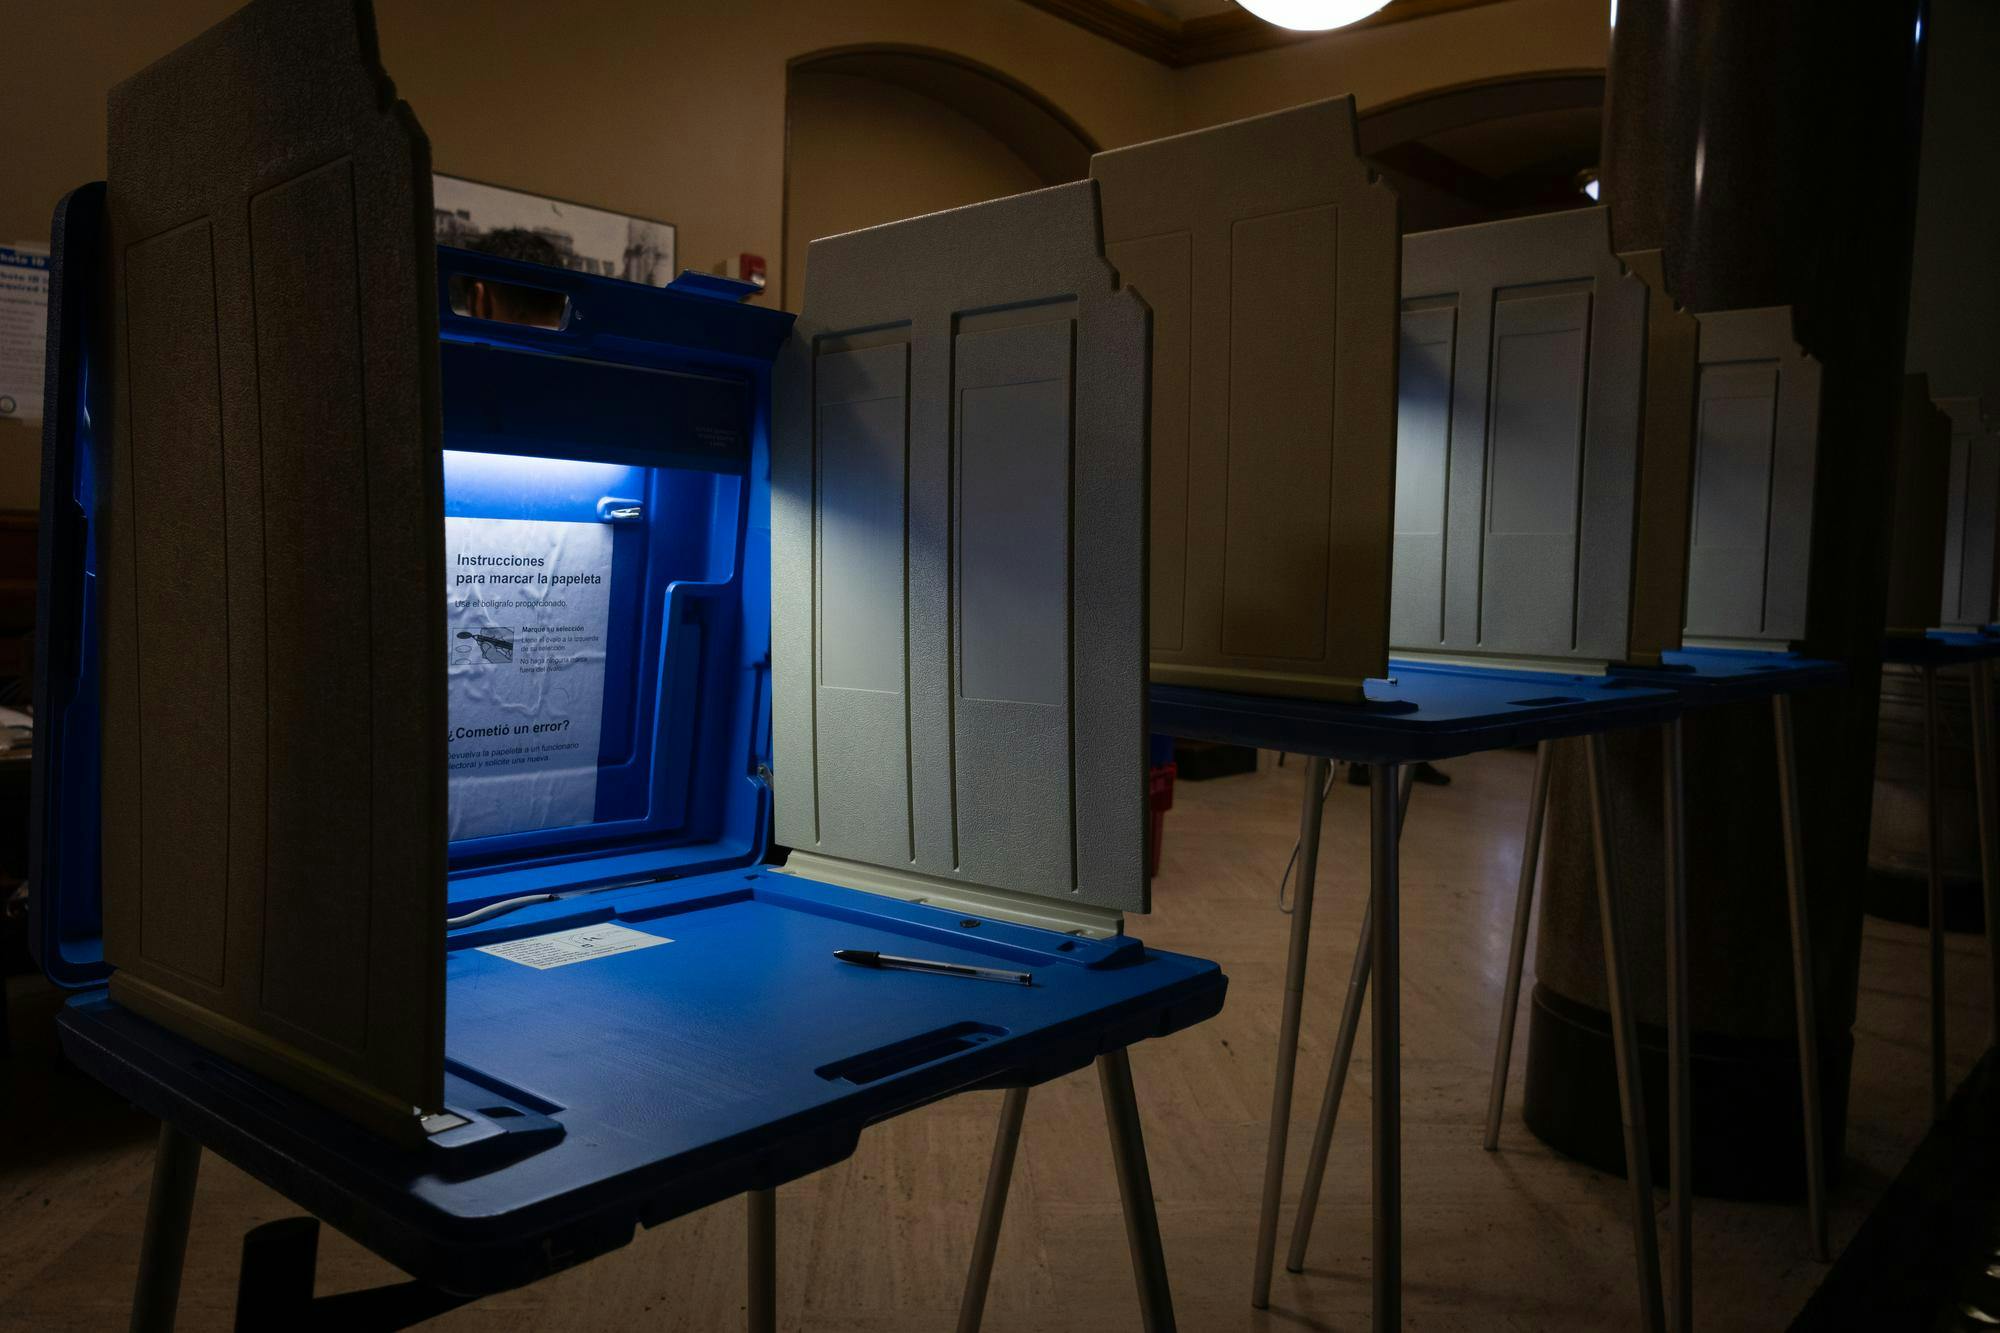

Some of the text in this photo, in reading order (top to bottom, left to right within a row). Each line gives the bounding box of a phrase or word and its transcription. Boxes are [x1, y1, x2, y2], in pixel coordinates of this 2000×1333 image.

[0, 253, 28, 265] hoto
[457, 554, 544, 566] Instrucciones
[457, 573, 601, 586] para marcar la papeleta
[481, 600, 513, 609] bolígrafo
[448, 720, 570, 742] ¿Cometió un error?
[491, 748, 523, 757] papeleta
[448, 761, 477, 770] lectoral
